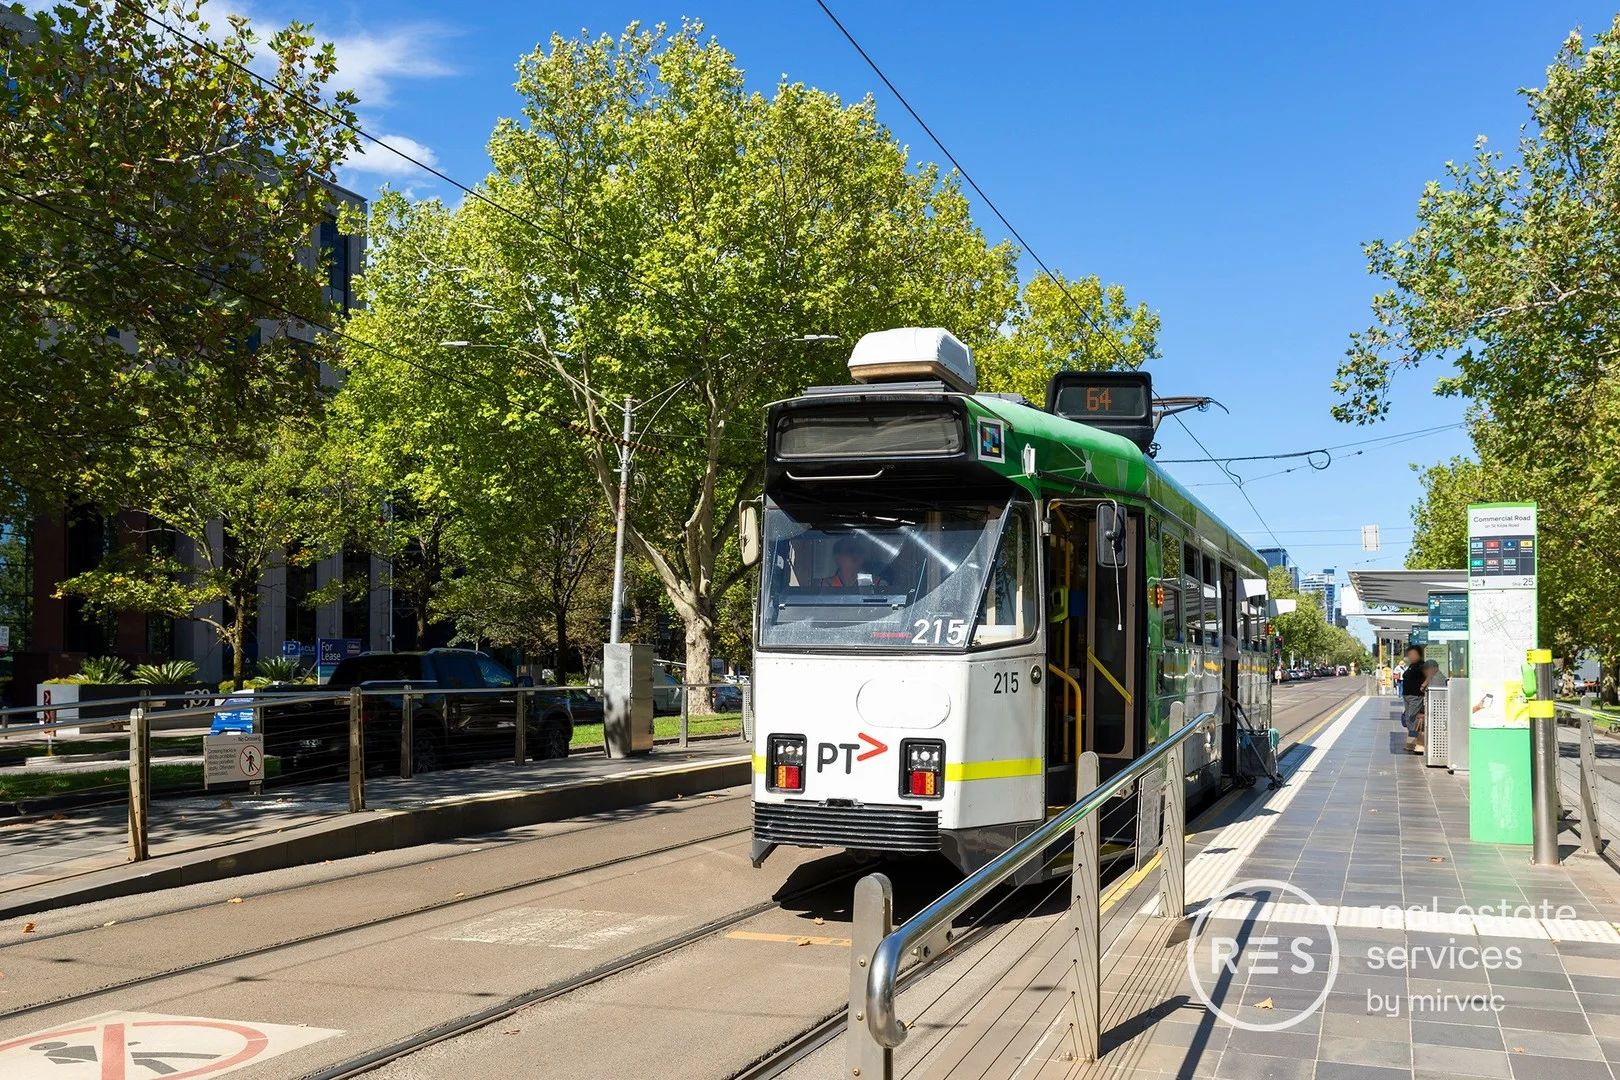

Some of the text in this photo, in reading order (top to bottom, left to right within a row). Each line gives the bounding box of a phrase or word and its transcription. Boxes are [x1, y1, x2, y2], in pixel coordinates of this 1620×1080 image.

[1086, 387, 1111, 411] 64
[1473, 515, 1513, 523] Commercial
[1523, 577, 1534, 586] 25
[911, 618, 965, 644] 215
[321, 641, 333, 651] For
[321, 651, 341, 661] Lease
[993, 671, 1019, 694] 215
